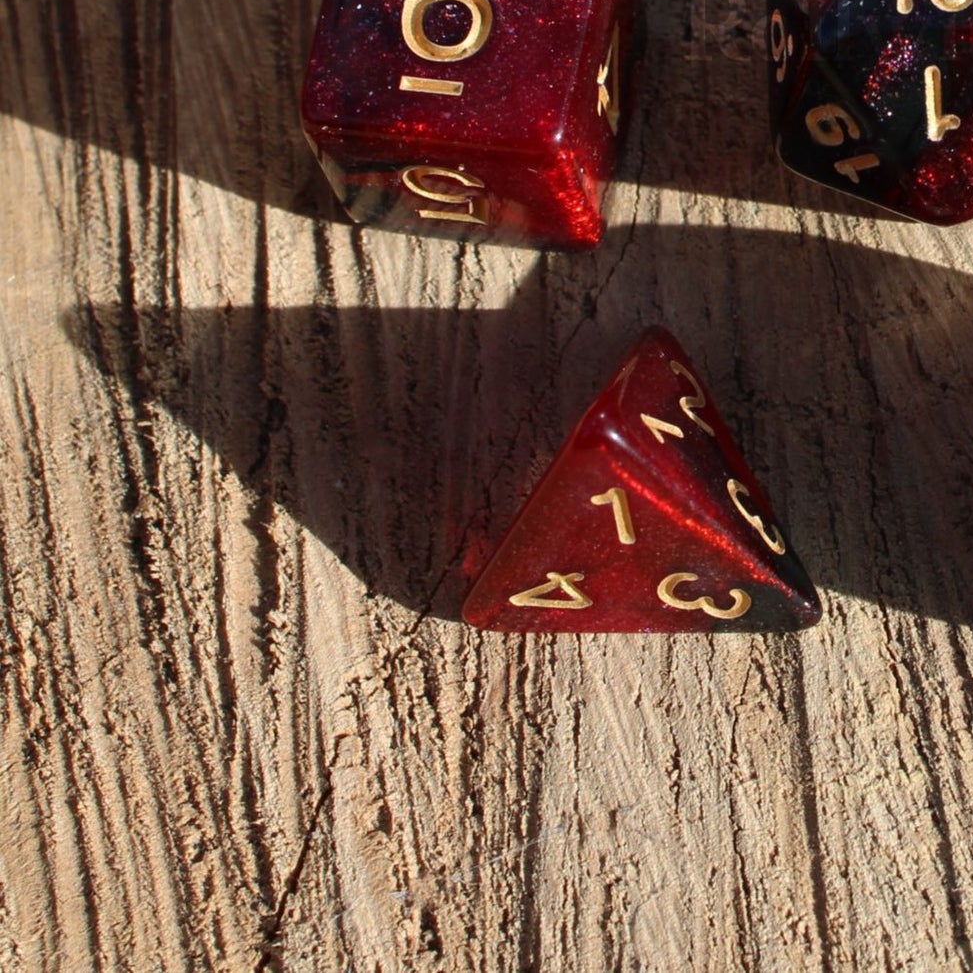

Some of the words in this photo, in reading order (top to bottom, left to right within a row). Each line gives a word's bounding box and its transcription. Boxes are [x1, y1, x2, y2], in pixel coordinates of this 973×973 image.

[924, 65, 961, 142] 1
[402, 165, 489, 224] 5
[726, 478, 786, 556] 3
[509, 572, 593, 610] 4
[657, 572, 752, 619] 3
